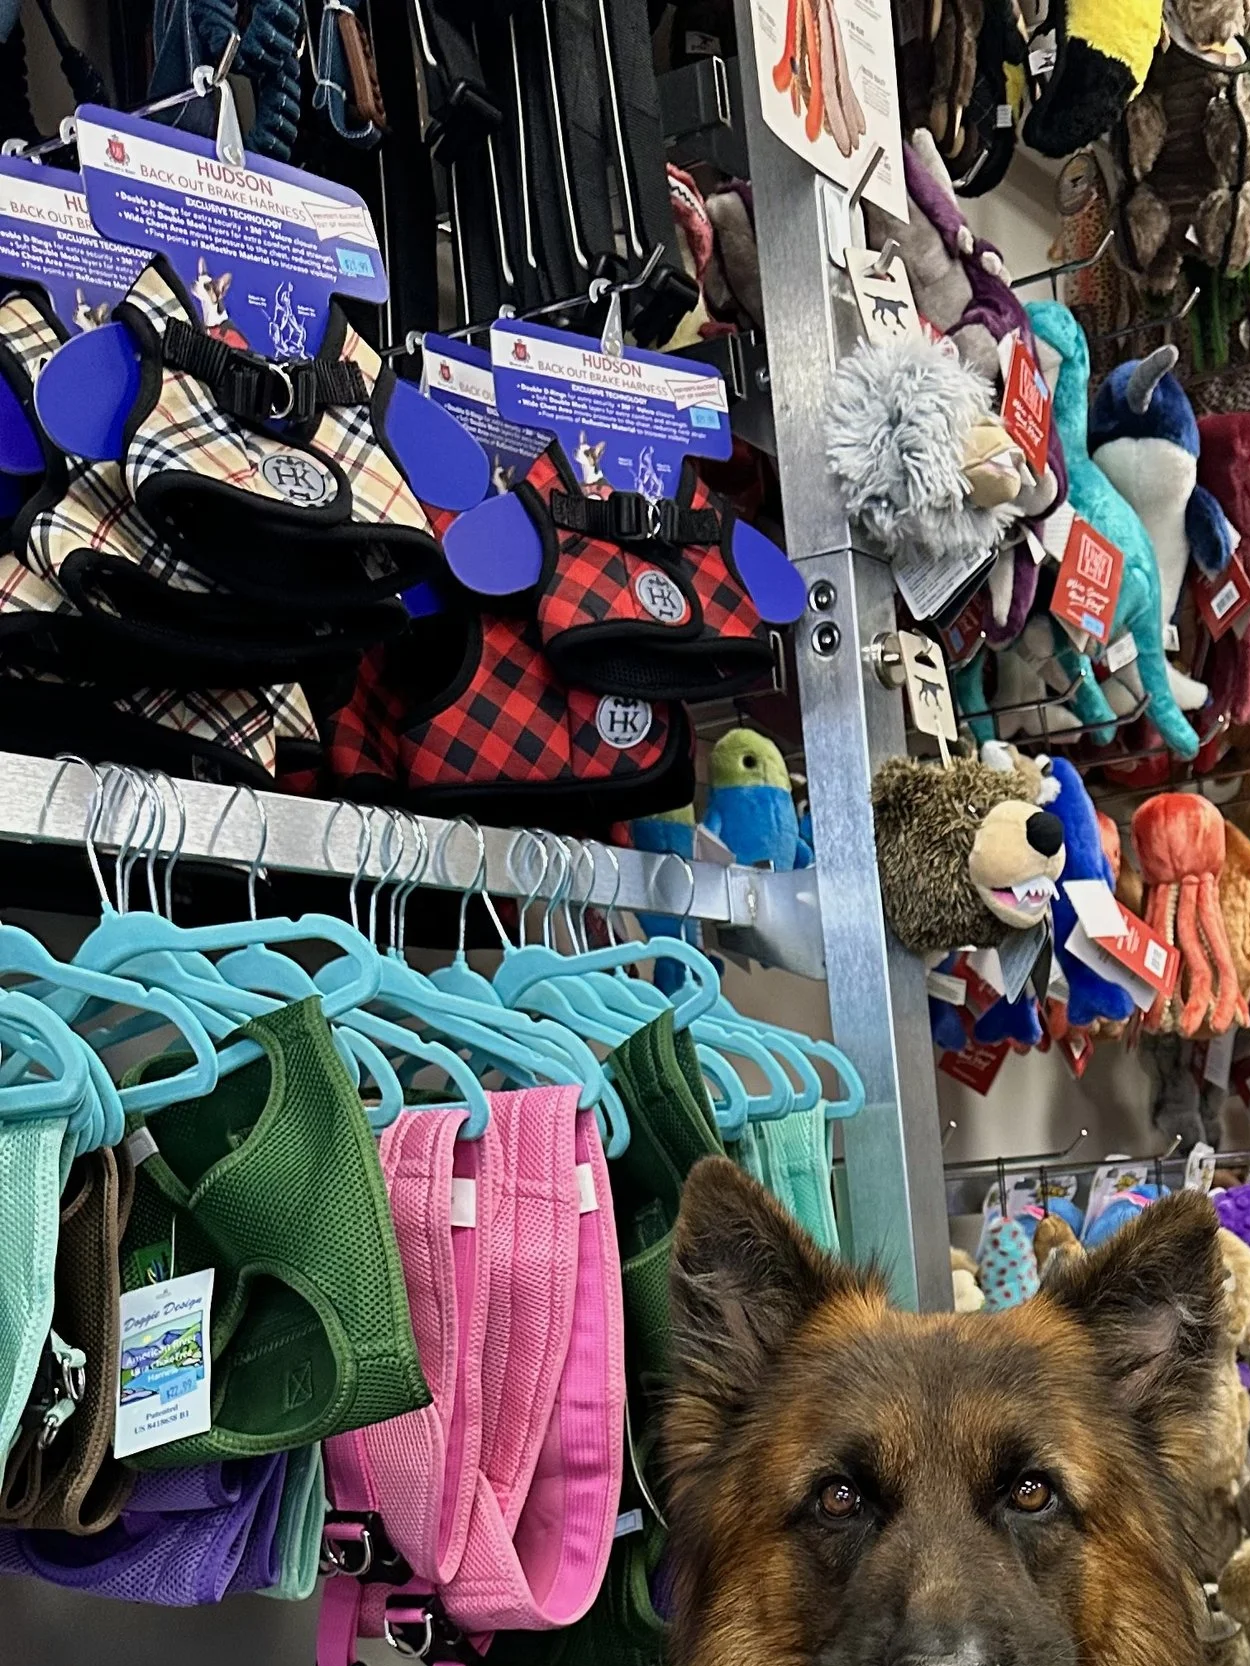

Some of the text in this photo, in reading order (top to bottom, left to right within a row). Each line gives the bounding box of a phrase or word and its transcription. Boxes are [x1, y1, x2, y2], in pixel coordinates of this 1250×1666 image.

[139, 163, 175, 185] BACK
[177, 174, 204, 193] OUT
[207, 183, 247, 205] BRAKE
[249, 195, 306, 221] HARNESS
[197, 159, 273, 196] HUDSON
[10, 200, 45, 219] BACK
[48, 210, 77, 227] OUT
[120, 191, 147, 206] Double
[180, 207, 191, 217] for
[192, 210, 211, 223] extra
[212, 216, 241, 232] security
[269, 230, 292, 244] Velcro
[139, 206, 155, 217] Soft
[156, 210, 184, 225] Double
[186, 218, 207, 230] Mesh
[208, 223, 229, 238] layers
[230, 229, 241, 239] for
[243, 233, 262, 245] extra
[263, 238, 290, 252] comfort
[291, 245, 305, 256] and
[184, 196, 282, 231] EXCLUSIVE TECHNOLOGY
[0, 228, 21, 240] ouble
[123, 211, 143, 223] Wide
[145, 217, 167, 229] Chest
[169, 223, 187, 234] Area
[189, 228, 212, 241] moves
[214, 235, 245, 250] pressure
[246, 242, 254, 251] to
[255, 245, 267, 255] the
[290, 254, 321, 269] reducing
[148, 227, 164, 239] Five
[166, 232, 189, 246] points
[190, 237, 199, 247] of
[200, 240, 236, 257] Reflective
[239, 250, 269, 265] Material
[271, 258, 279, 267] to
[280, 260, 308, 275] increase
[538, 361, 565, 376] BACK
[567, 367, 587, 380] OUT
[590, 371, 620, 387] BRAKE
[622, 380, 669, 397] HARNESS
[582, 353, 641, 378] HUDSON
[571, 383, 647, 405] EXCLUSIVE TECHNOLOGY
[124, 1297, 202, 1332] Doggie Design
[126, 1335, 196, 1364] American River
[134, 1425, 146, 1434] US
[146, 1404, 179, 1420] Patented
